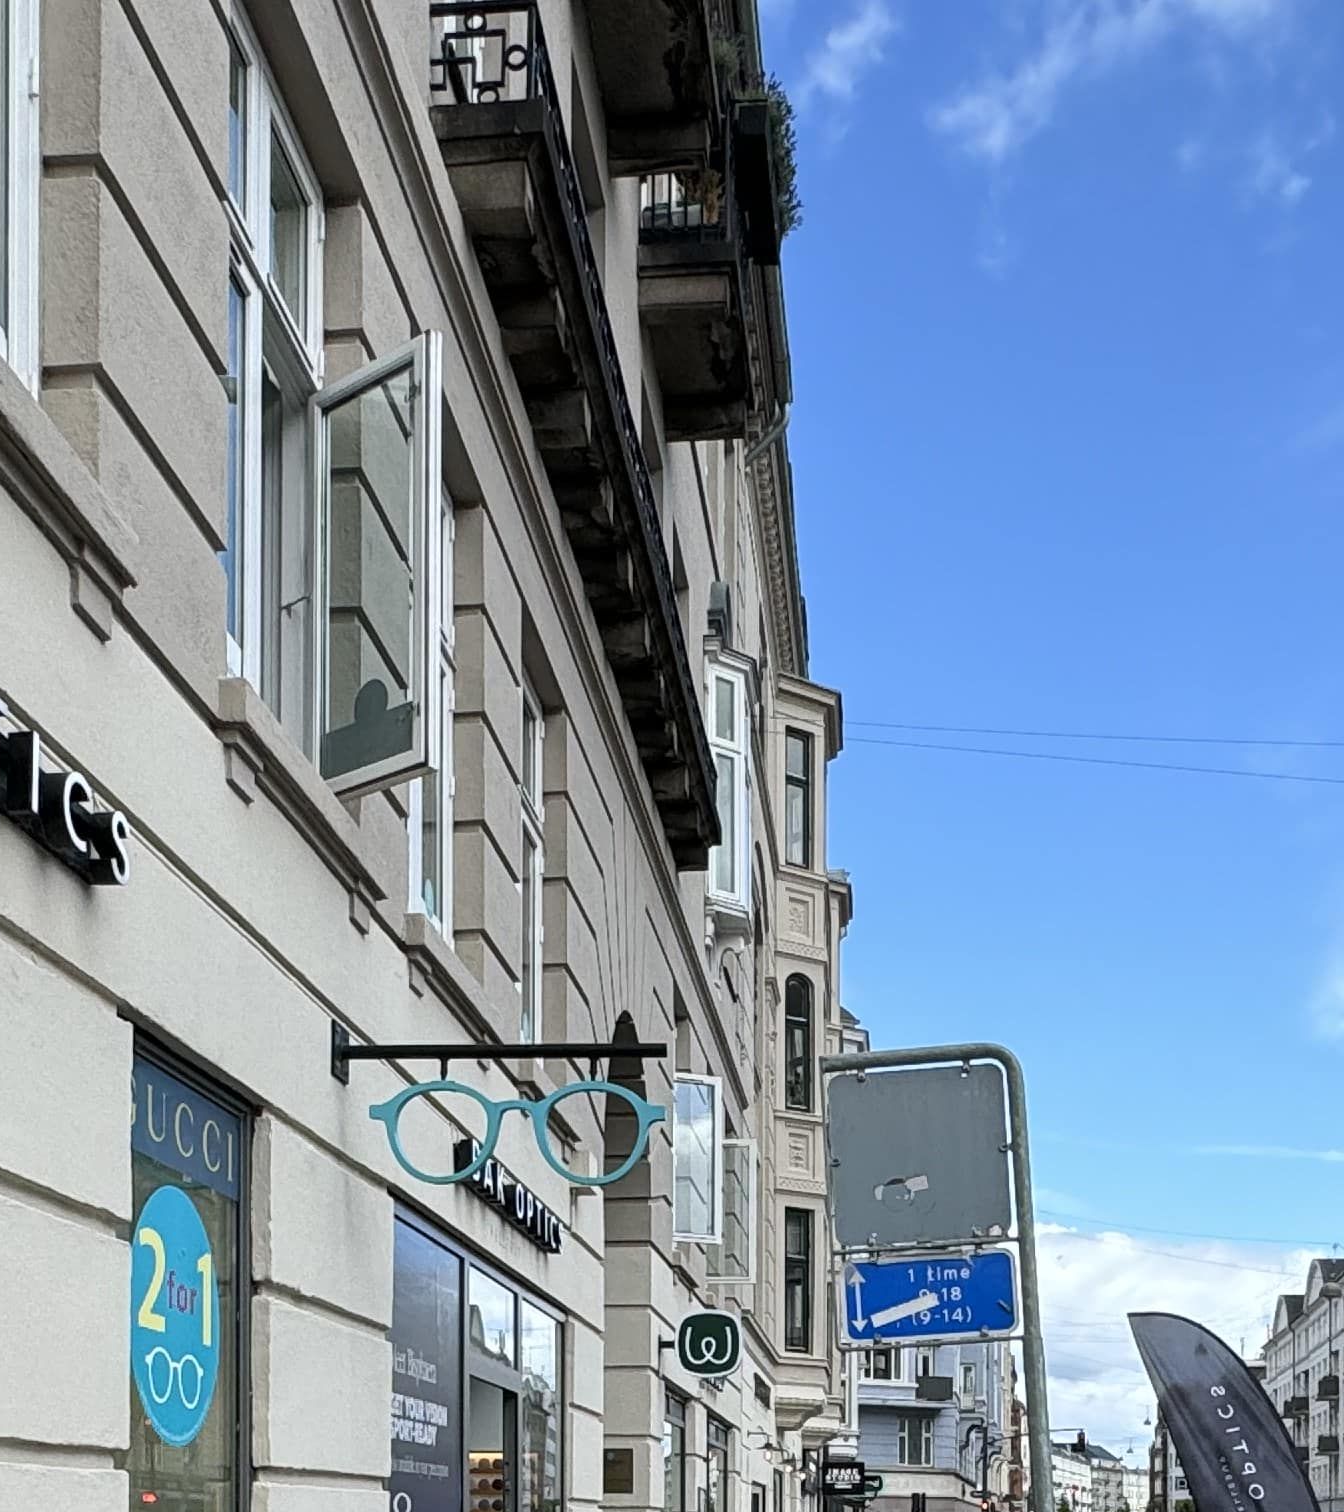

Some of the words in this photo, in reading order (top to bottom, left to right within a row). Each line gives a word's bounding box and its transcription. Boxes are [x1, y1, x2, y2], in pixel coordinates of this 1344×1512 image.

[132, 1075, 234, 1183] UCCI
[515, 1182, 565, 1255] OPTICS
[138, 1227, 166, 1333] 2
[166, 1269, 198, 1315] for
[197, 1251, 213, 1347] 1
[907, 1268, 915, 1283] 1
[927, 1264, 971, 1282] time
